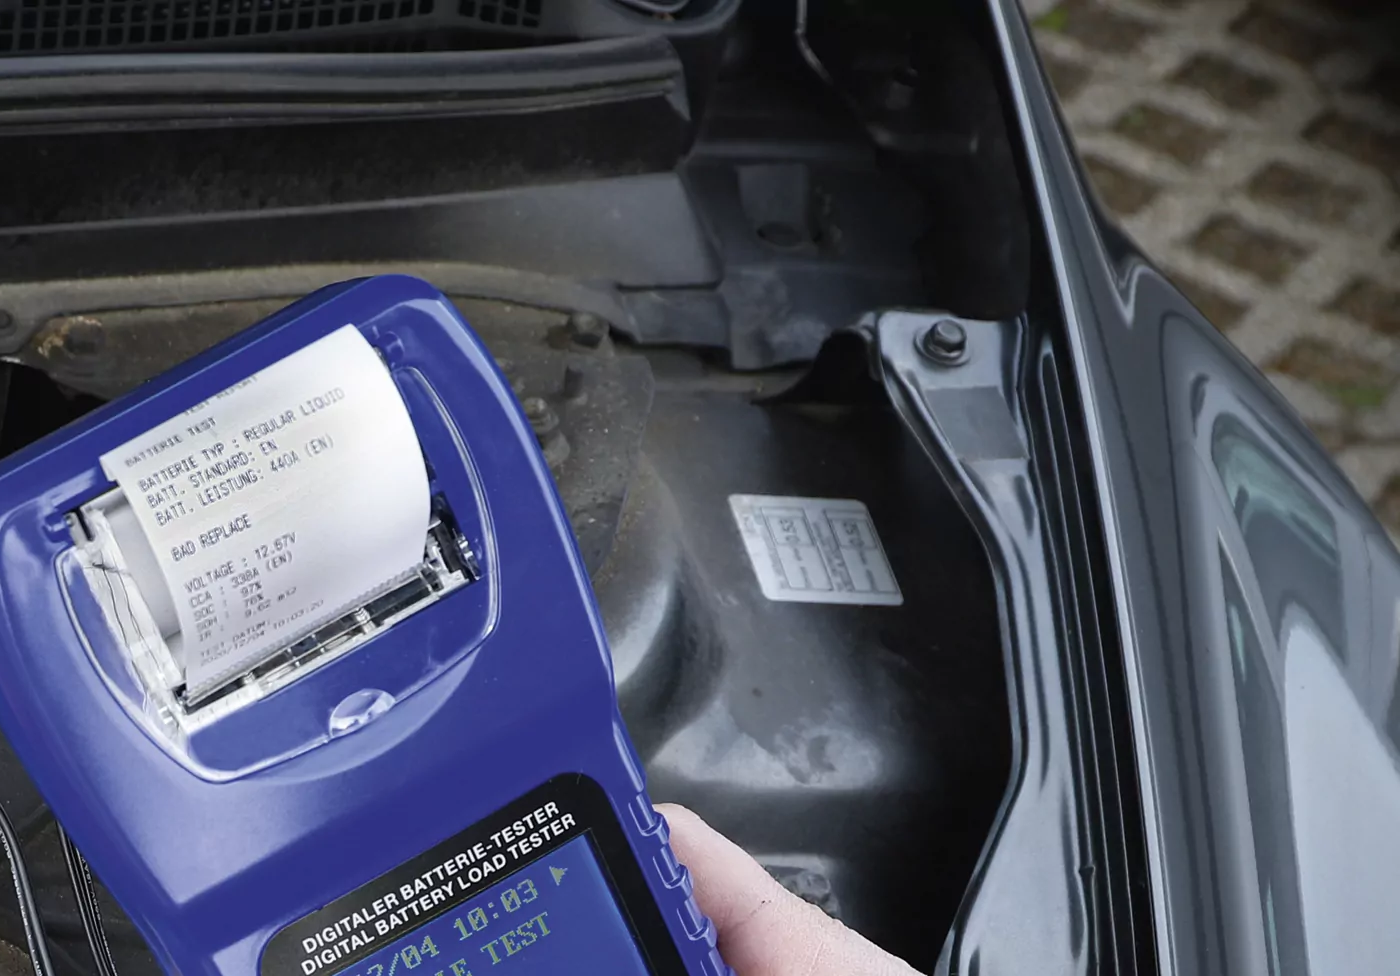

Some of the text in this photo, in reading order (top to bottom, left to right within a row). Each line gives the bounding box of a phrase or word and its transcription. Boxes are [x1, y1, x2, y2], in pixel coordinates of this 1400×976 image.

[139, 456, 198, 492] BATTERIE
[202, 443, 224, 461] TYP
[243, 410, 296, 442] REGULAR
[300, 387, 345, 418] LIQUID
[147, 439, 277, 508] BATT. STANDARD: EN
[155, 436, 333, 526] BATT. LEISTUNG: 440A (EN)
[171, 514, 251, 561] BAD REPLACE
[185, 561, 235, 593] VOLTAGE
[255, 532, 295, 560] 12.67V
[189, 591, 212, 608] CCA
[301, 813, 576, 976] DIGITAL BATTERY LOAD TESTER
[302, 802, 559, 954] DIGITALER BATTERIE-TESTER
[453, 879, 538, 941] 10:03
[480, 912, 550, 964] TEST
